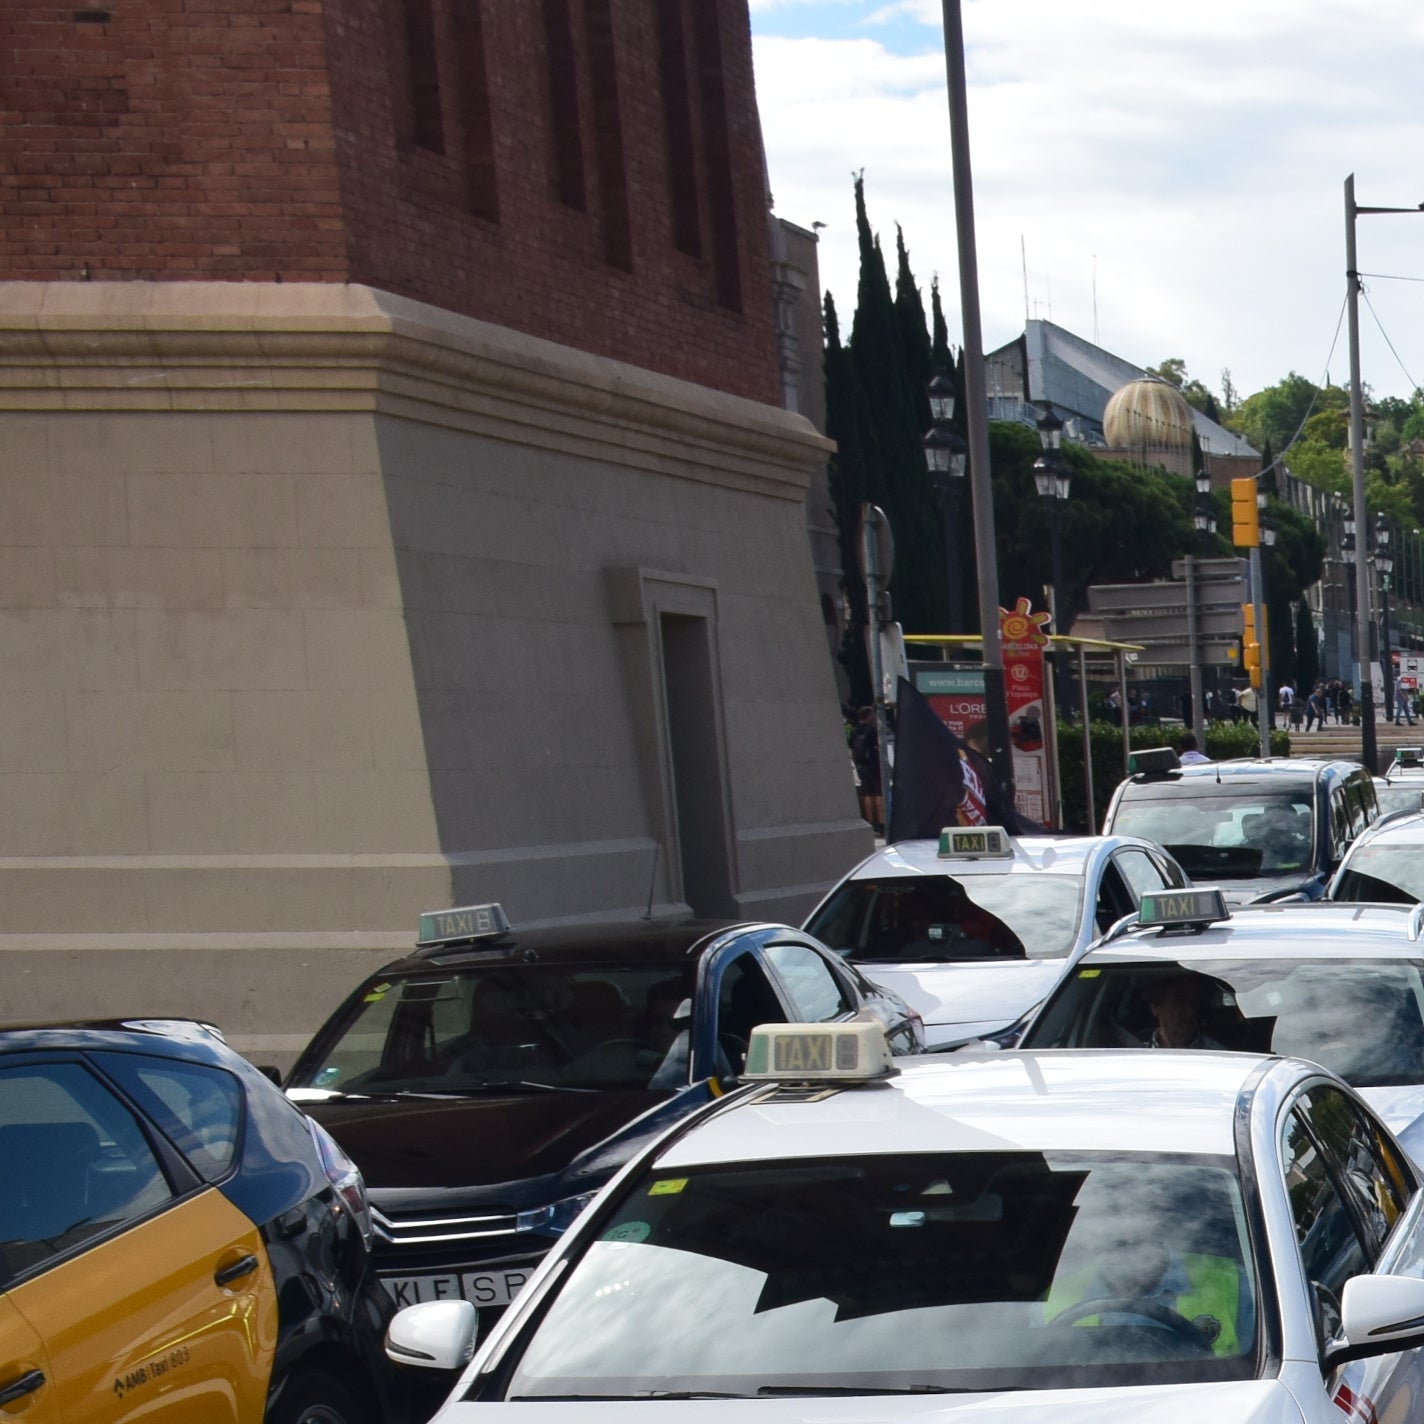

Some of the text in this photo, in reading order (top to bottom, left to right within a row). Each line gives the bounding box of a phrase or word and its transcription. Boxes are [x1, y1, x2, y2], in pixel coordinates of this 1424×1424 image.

[954, 833, 986, 851] TAXI
[1159, 896, 1195, 917] TAXI
[438, 913, 474, 936] TAXI
[776, 1036, 833, 1069] TAXI
[472, 1272, 528, 1302] SP
[125, 1346, 190, 1391] AMB Taxi 803
